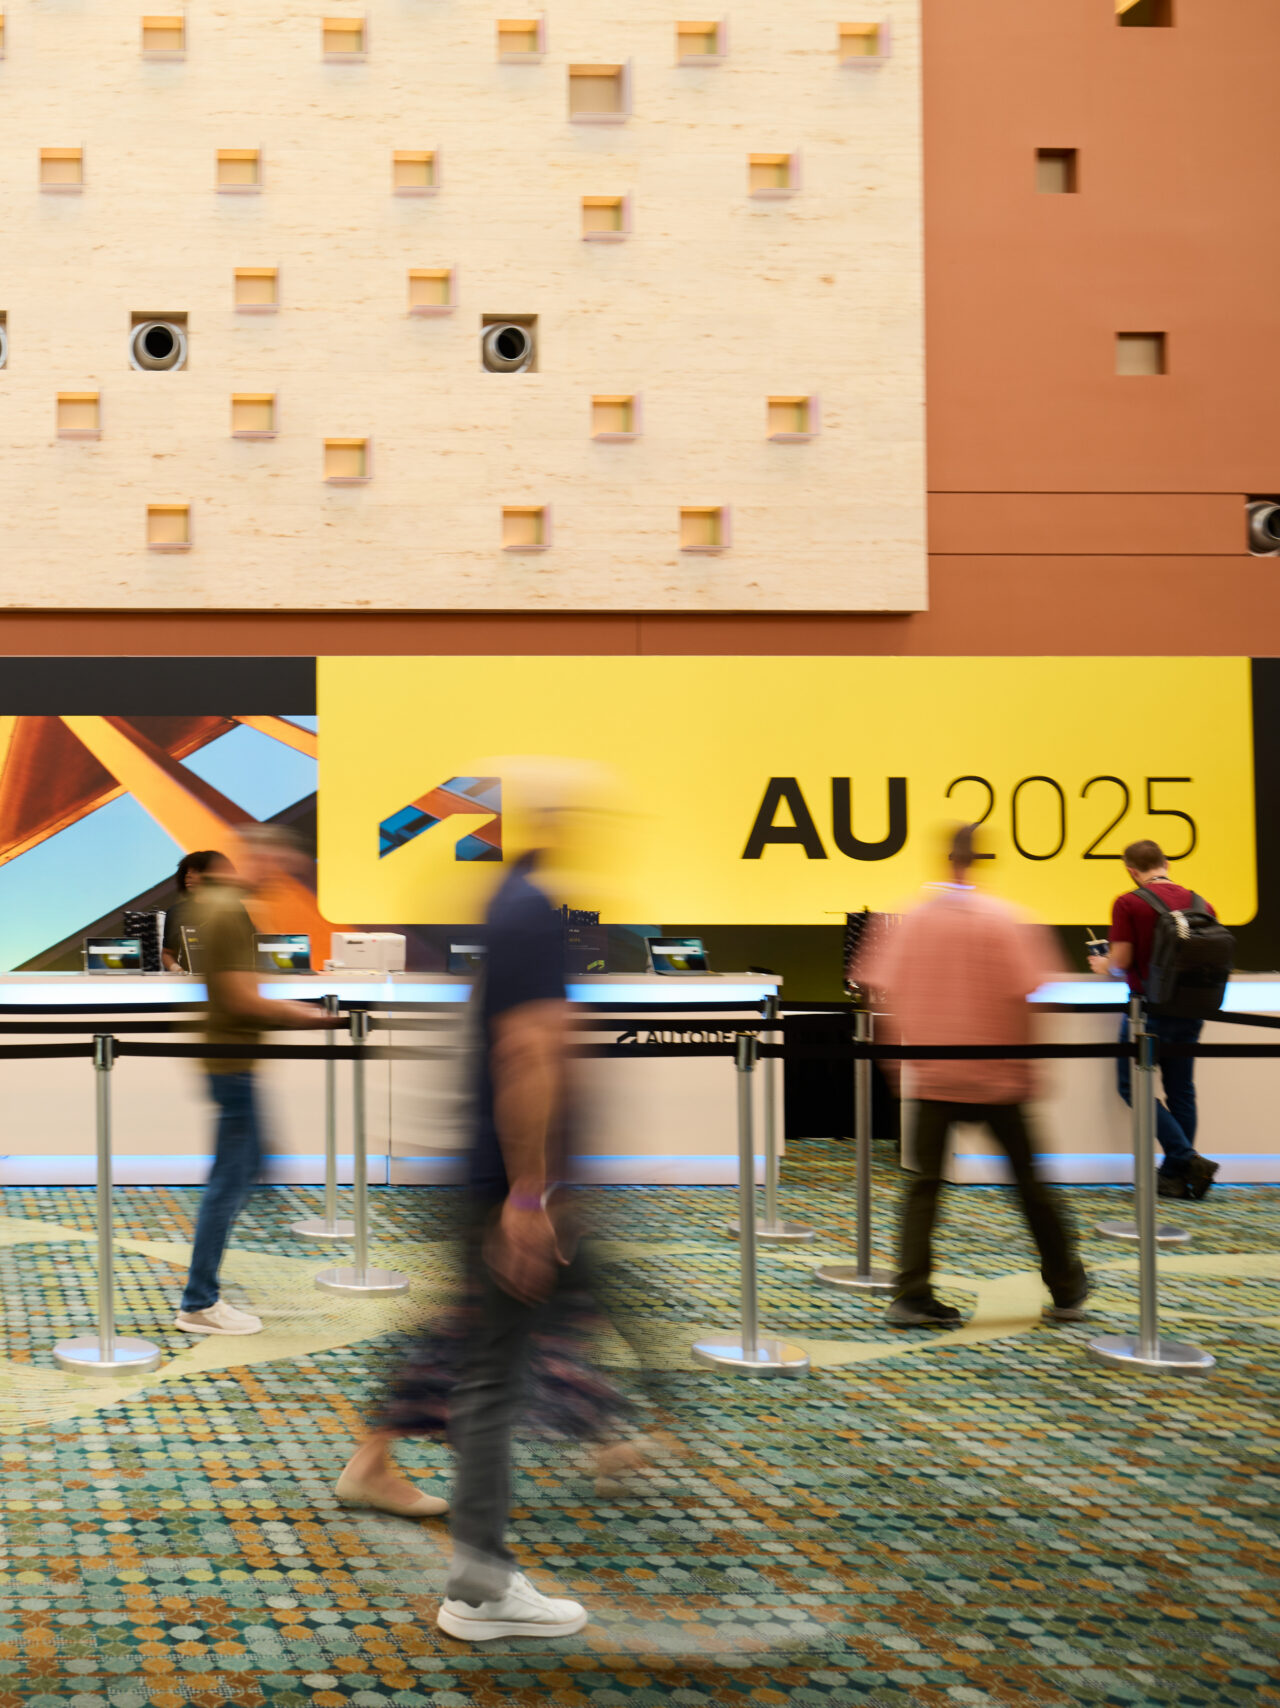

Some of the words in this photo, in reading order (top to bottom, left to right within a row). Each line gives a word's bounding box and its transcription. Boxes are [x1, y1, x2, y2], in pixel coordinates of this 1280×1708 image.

[741, 776, 908, 861] AU
[944, 775, 1198, 861] 2025
[646, 1030, 760, 1044] AUTODE
